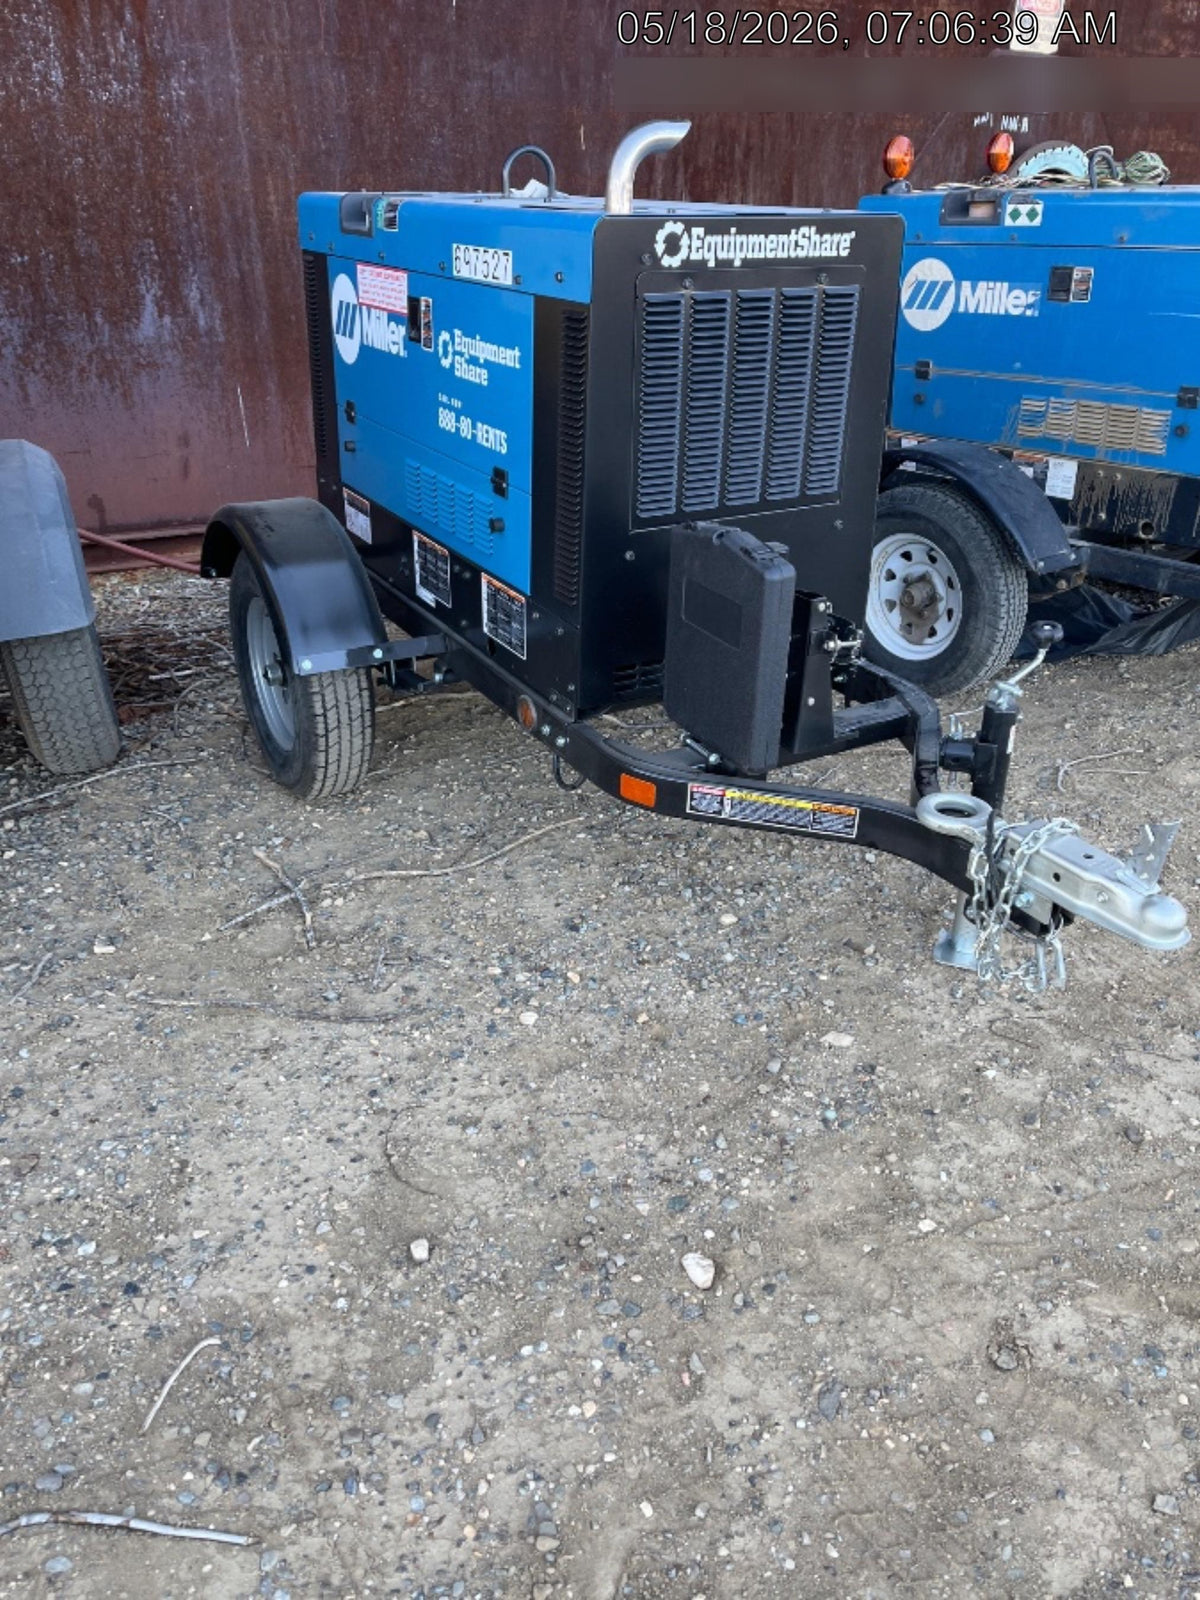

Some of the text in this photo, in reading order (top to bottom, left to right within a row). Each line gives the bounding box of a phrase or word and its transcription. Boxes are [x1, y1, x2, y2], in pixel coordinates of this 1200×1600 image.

[454, 244, 511, 281] 697527
[689, 225, 854, 268] EquipmentShare
[360, 306, 408, 358] Miller
[453, 328, 521, 369] Equipment
[454, 355, 488, 386] Share
[438, 406, 508, 455] 888-80-RENTS
